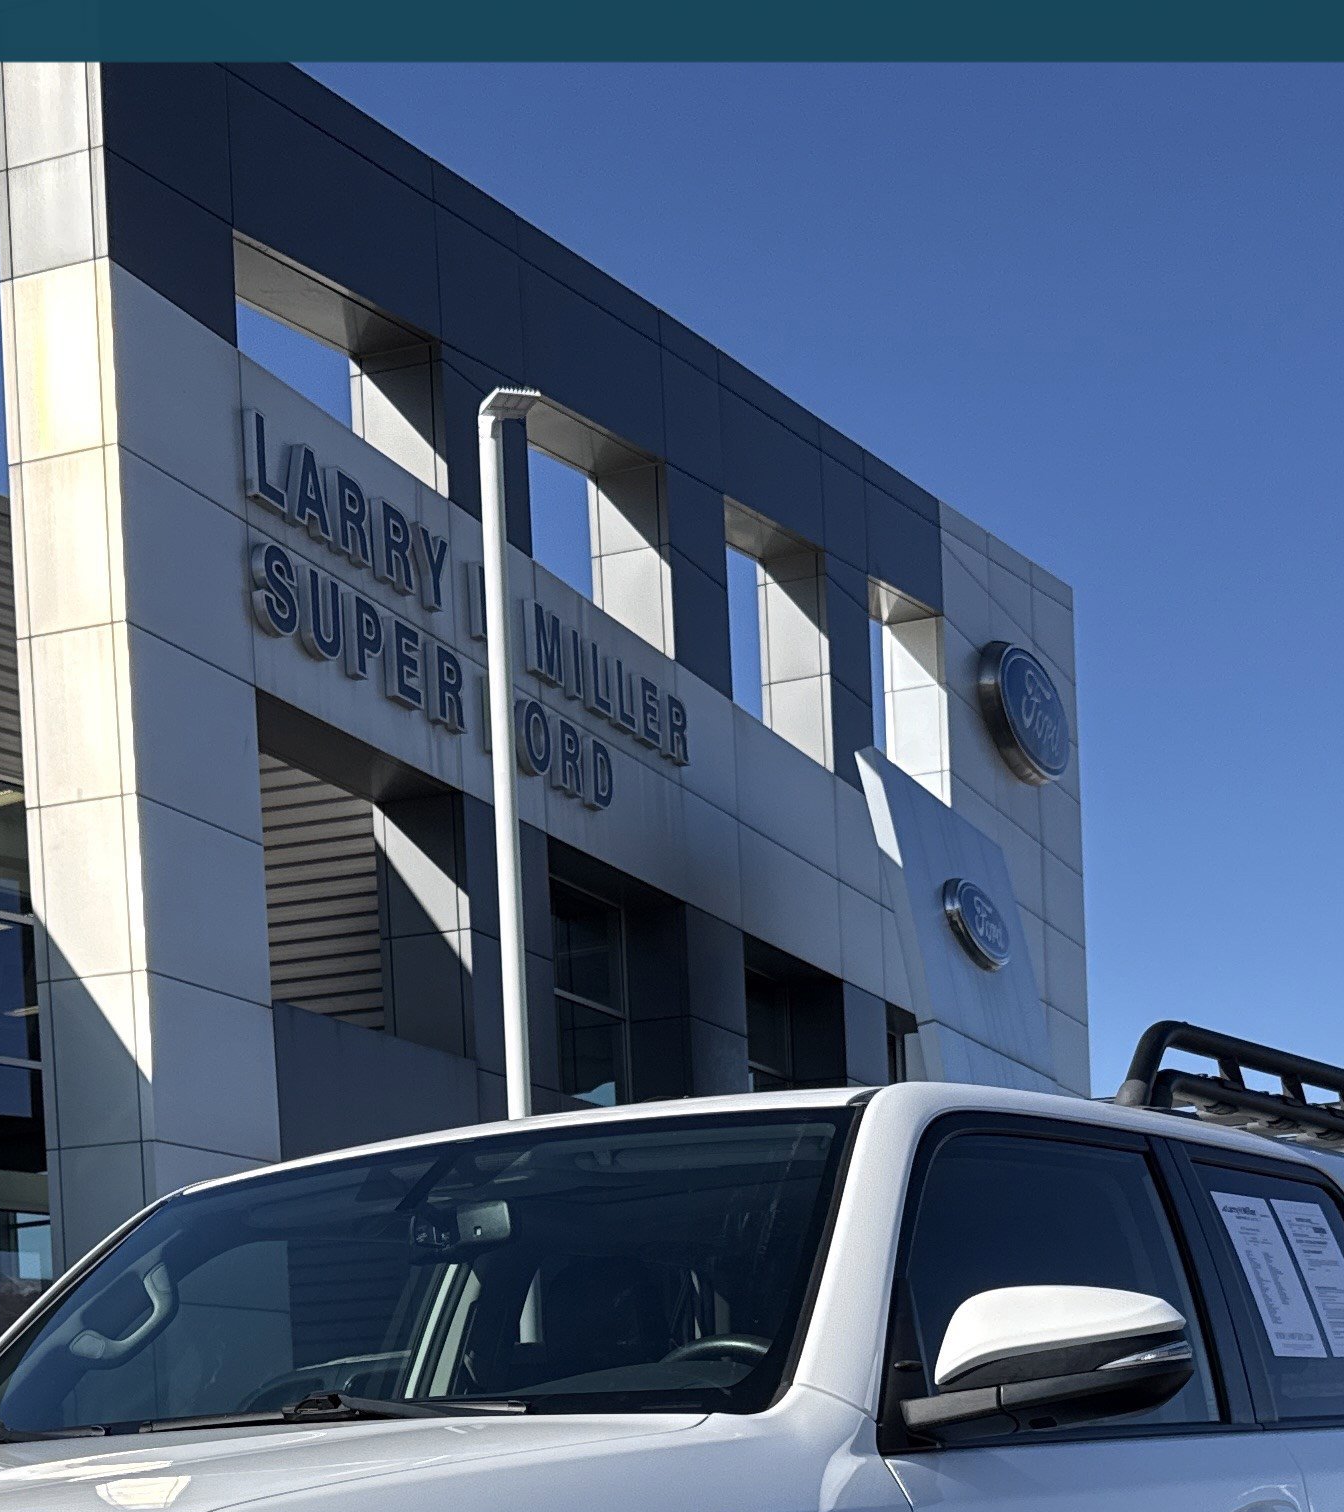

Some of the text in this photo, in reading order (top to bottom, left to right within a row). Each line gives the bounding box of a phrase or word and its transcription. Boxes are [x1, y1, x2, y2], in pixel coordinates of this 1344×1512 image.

[245, 408, 449, 612] LARRY
[523, 600, 690, 766] MILLER
[253, 542, 466, 735] SUPER
[484, 676, 614, 811] ORD
[1020, 668, 1064, 757] Ford
[974, 896, 1005, 950] Ford
